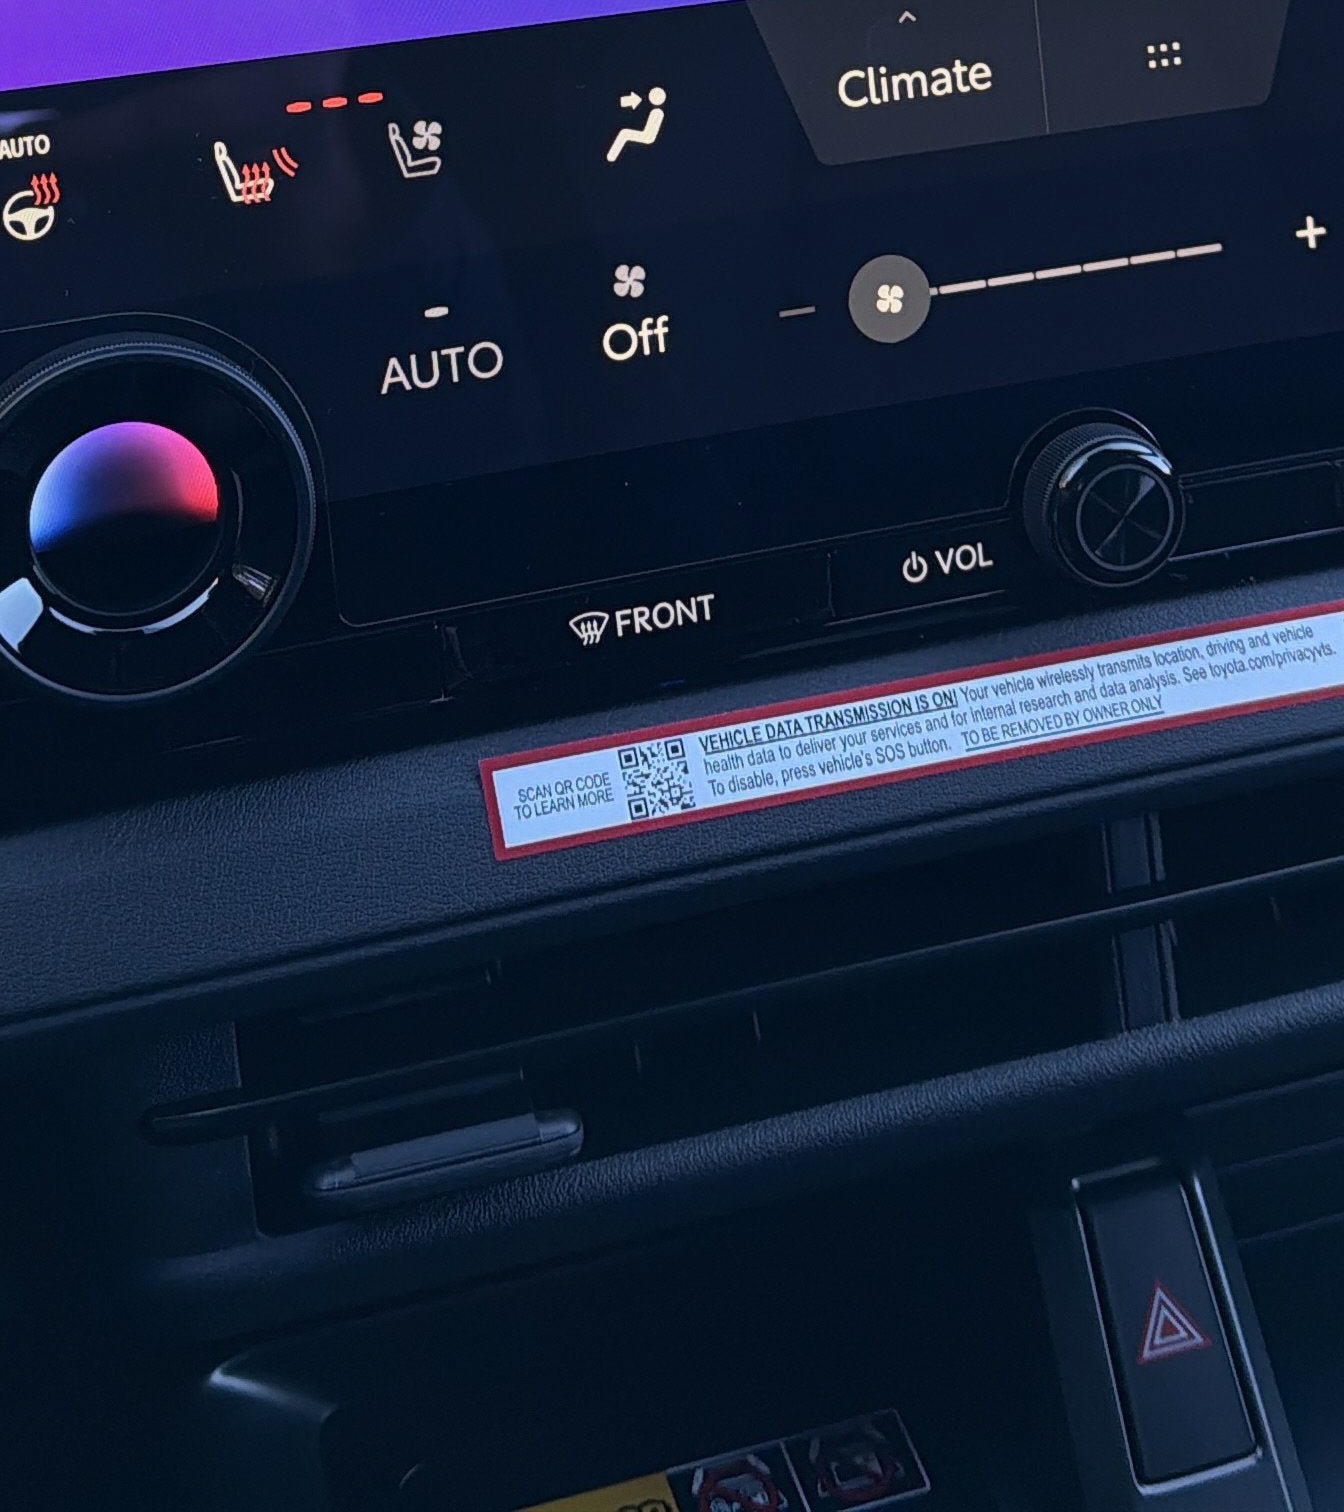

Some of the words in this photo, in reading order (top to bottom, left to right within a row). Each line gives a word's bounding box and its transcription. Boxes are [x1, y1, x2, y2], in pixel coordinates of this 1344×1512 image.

[836, 58, 993, 110] Climate
[602, 315, 670, 362] Off
[380, 341, 504, 395] AUTO
[934, 541, 994, 576] VOL
[615, 594, 716, 638] FRONT
[699, 727, 763, 755] VEHICLE
[766, 718, 804, 741] DATA
[806, 697, 913, 735] TRANSMISSION
[914, 694, 930, 712] IS
[932, 687, 958, 708] ON!
[960, 682, 989, 704] Your
[993, 674, 1035, 697] vehicle
[1036, 663, 1095, 688] wirelessly
[1098, 654, 1153, 679] transmits
[1153, 646, 1204, 667] location,
[1206, 635, 1246, 657] driving
[1248, 632, 1271, 650] and
[1273, 623, 1315, 644] vehicle
[704, 752, 745, 777] health
[747, 745, 777, 766] data
[779, 744, 792, 760] to
[795, 733, 837, 759] deliver
[838, 729, 868, 752] your
[870, 719, 923, 744] services
[926, 714, 949, 733] and
[951, 708, 969, 730] for
[971, 698, 1017, 724] internal
[1019, 689, 1073, 714] research
[1074, 681, 1098, 704] and
[1099, 678, 1128, 700] data
[1128, 670, 1181, 694] analysis.
[1182, 665, 1208, 683] See
[707, 779, 726, 798] To
[727, 766, 780, 794] disable,
[781, 764, 817, 787] press
[818, 749, 873, 777] vehicle's
[875, 743, 906, 766] SOS
[907, 734, 953, 759] button.
[960, 728, 981, 747] TO
[983, 724, 1000, 742] BE
[1001, 713, 1064, 740] REMOVED
[1064, 709, 1081, 728] BY
[1083, 699, 1130, 723] OWNER
[1131, 693, 1164, 715] ONLY
[513, 804, 533, 821] TO
[533, 796, 576, 818] LEARN
[577, 787, 615, 807] MORE
[517, 784, 553, 804] SCAN
[554, 779, 574, 796] QR
[575, 771, 612, 791] CODE
